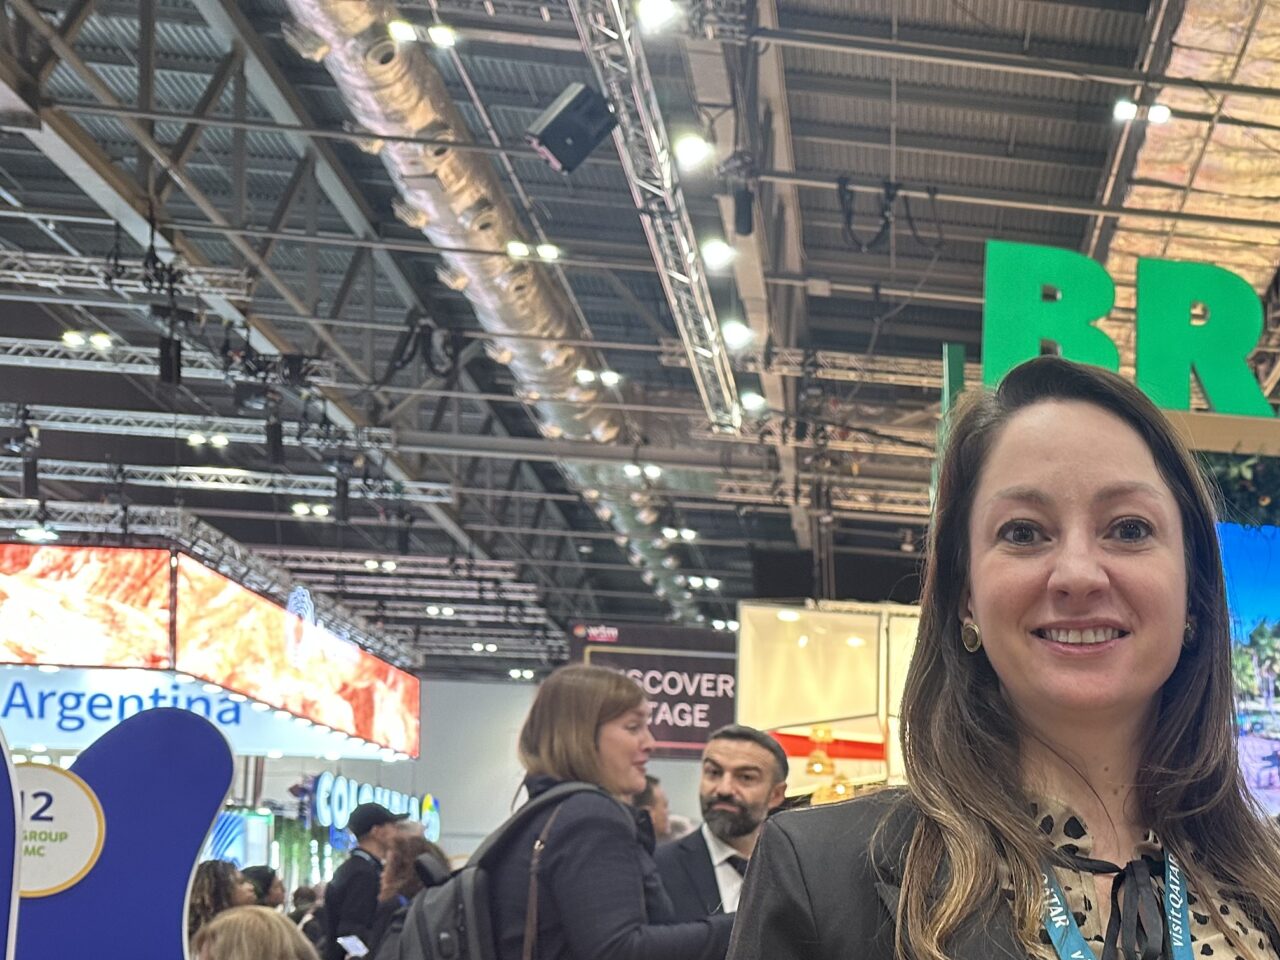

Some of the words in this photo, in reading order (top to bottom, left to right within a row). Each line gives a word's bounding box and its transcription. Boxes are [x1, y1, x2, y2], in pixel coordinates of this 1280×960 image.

[624, 668, 735, 698] COVER
[1, 680, 241, 731] Argentina
[646, 701, 710, 728] TAGE
